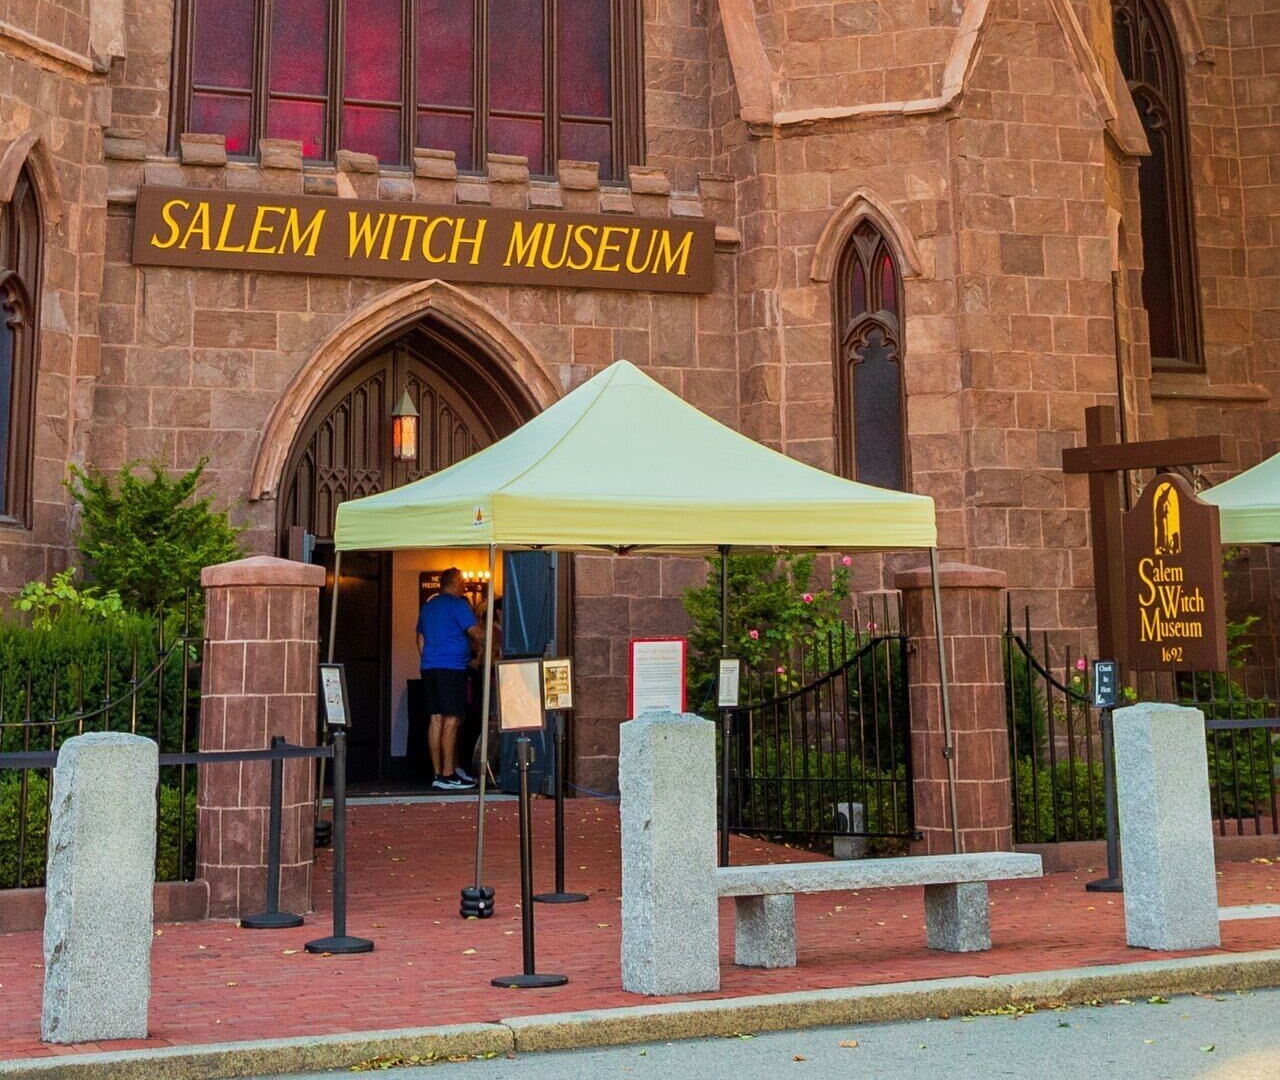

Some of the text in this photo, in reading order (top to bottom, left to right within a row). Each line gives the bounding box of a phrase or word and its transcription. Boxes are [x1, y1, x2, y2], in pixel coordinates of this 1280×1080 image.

[151, 199, 694, 275] SALEM WITCH MUSEUM
[1138, 558, 1183, 606] Salem
[1157, 585, 1205, 619] Witch
[1139, 607, 1203, 642] Museum
[1161, 647, 1183, 662] 1692
